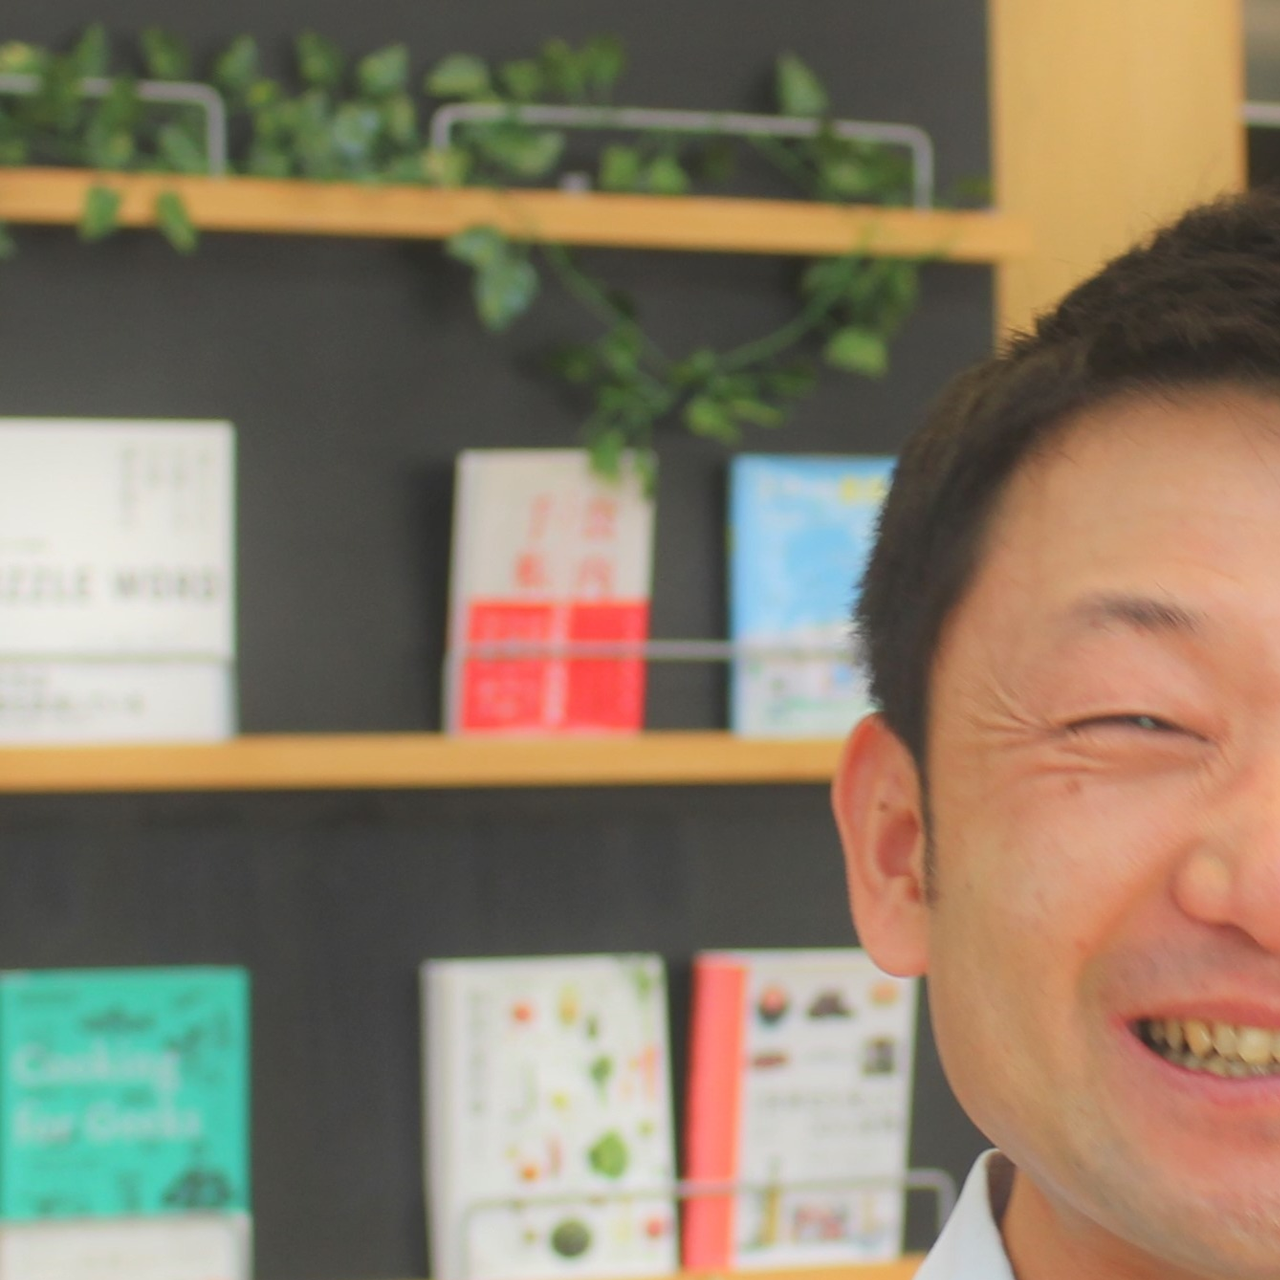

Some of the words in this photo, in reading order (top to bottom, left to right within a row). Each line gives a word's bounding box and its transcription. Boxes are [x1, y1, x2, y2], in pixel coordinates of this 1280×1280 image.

[114, 565, 221, 604] WORD
[12, 1042, 182, 1098] Cooking
[12, 1100, 76, 1145] for
[86, 1100, 203, 1144] Geeks
